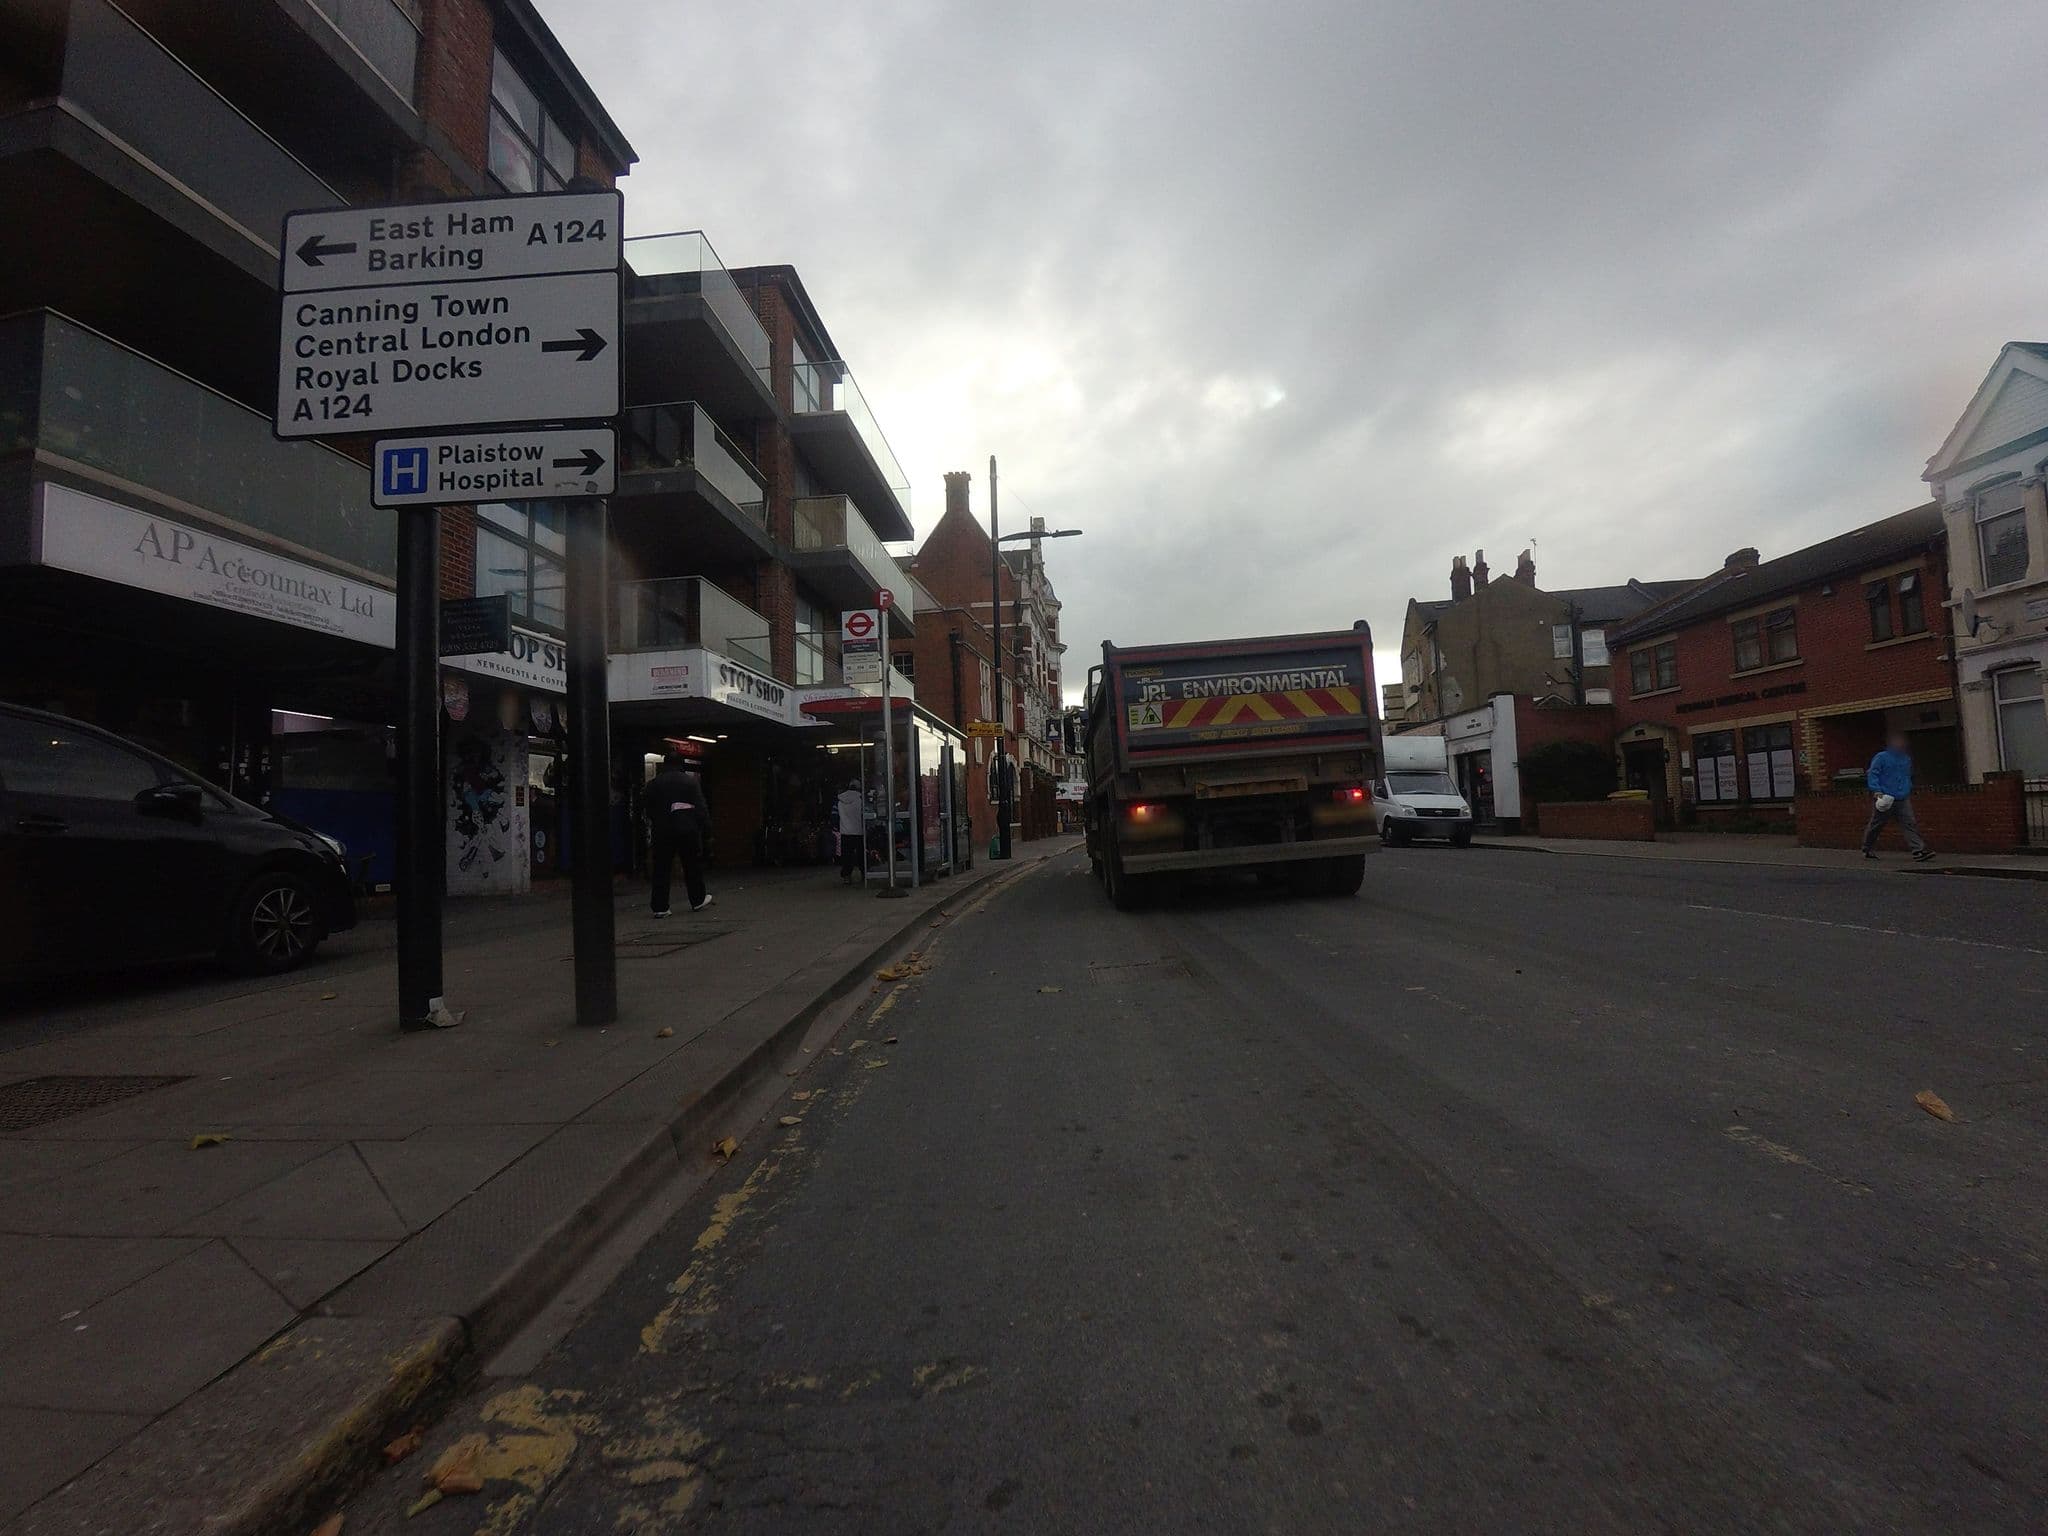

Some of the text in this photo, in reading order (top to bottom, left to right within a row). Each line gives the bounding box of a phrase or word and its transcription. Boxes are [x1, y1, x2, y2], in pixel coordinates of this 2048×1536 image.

[369, 212, 514, 242] East Ham
[526, 219, 607, 246] A124
[367, 246, 484, 272] Barking
[295, 294, 509, 327] Canning Town
[294, 322, 531, 359] Central London
[295, 356, 483, 393] Royal Docks
[292, 394, 374, 422] A124
[438, 443, 544, 466] Plaistow
[389, 452, 421, 491] H
[438, 467, 544, 493] Hospital
[133, 521, 196, 566] AP
[196, 545, 333, 607] Accountax
[340, 586, 375, 619] Ltd
[879, 592, 889, 606] F
[510, 632, 539, 663] OP
[476, 658, 530, 679] NEWSAGENTS
[720, 663, 754, 694] STOP
[755, 679, 785, 707] SHOP
[1138, 684, 1172, 703] JRL
[1182, 669, 1350, 699] ENVIRONMENTAL
